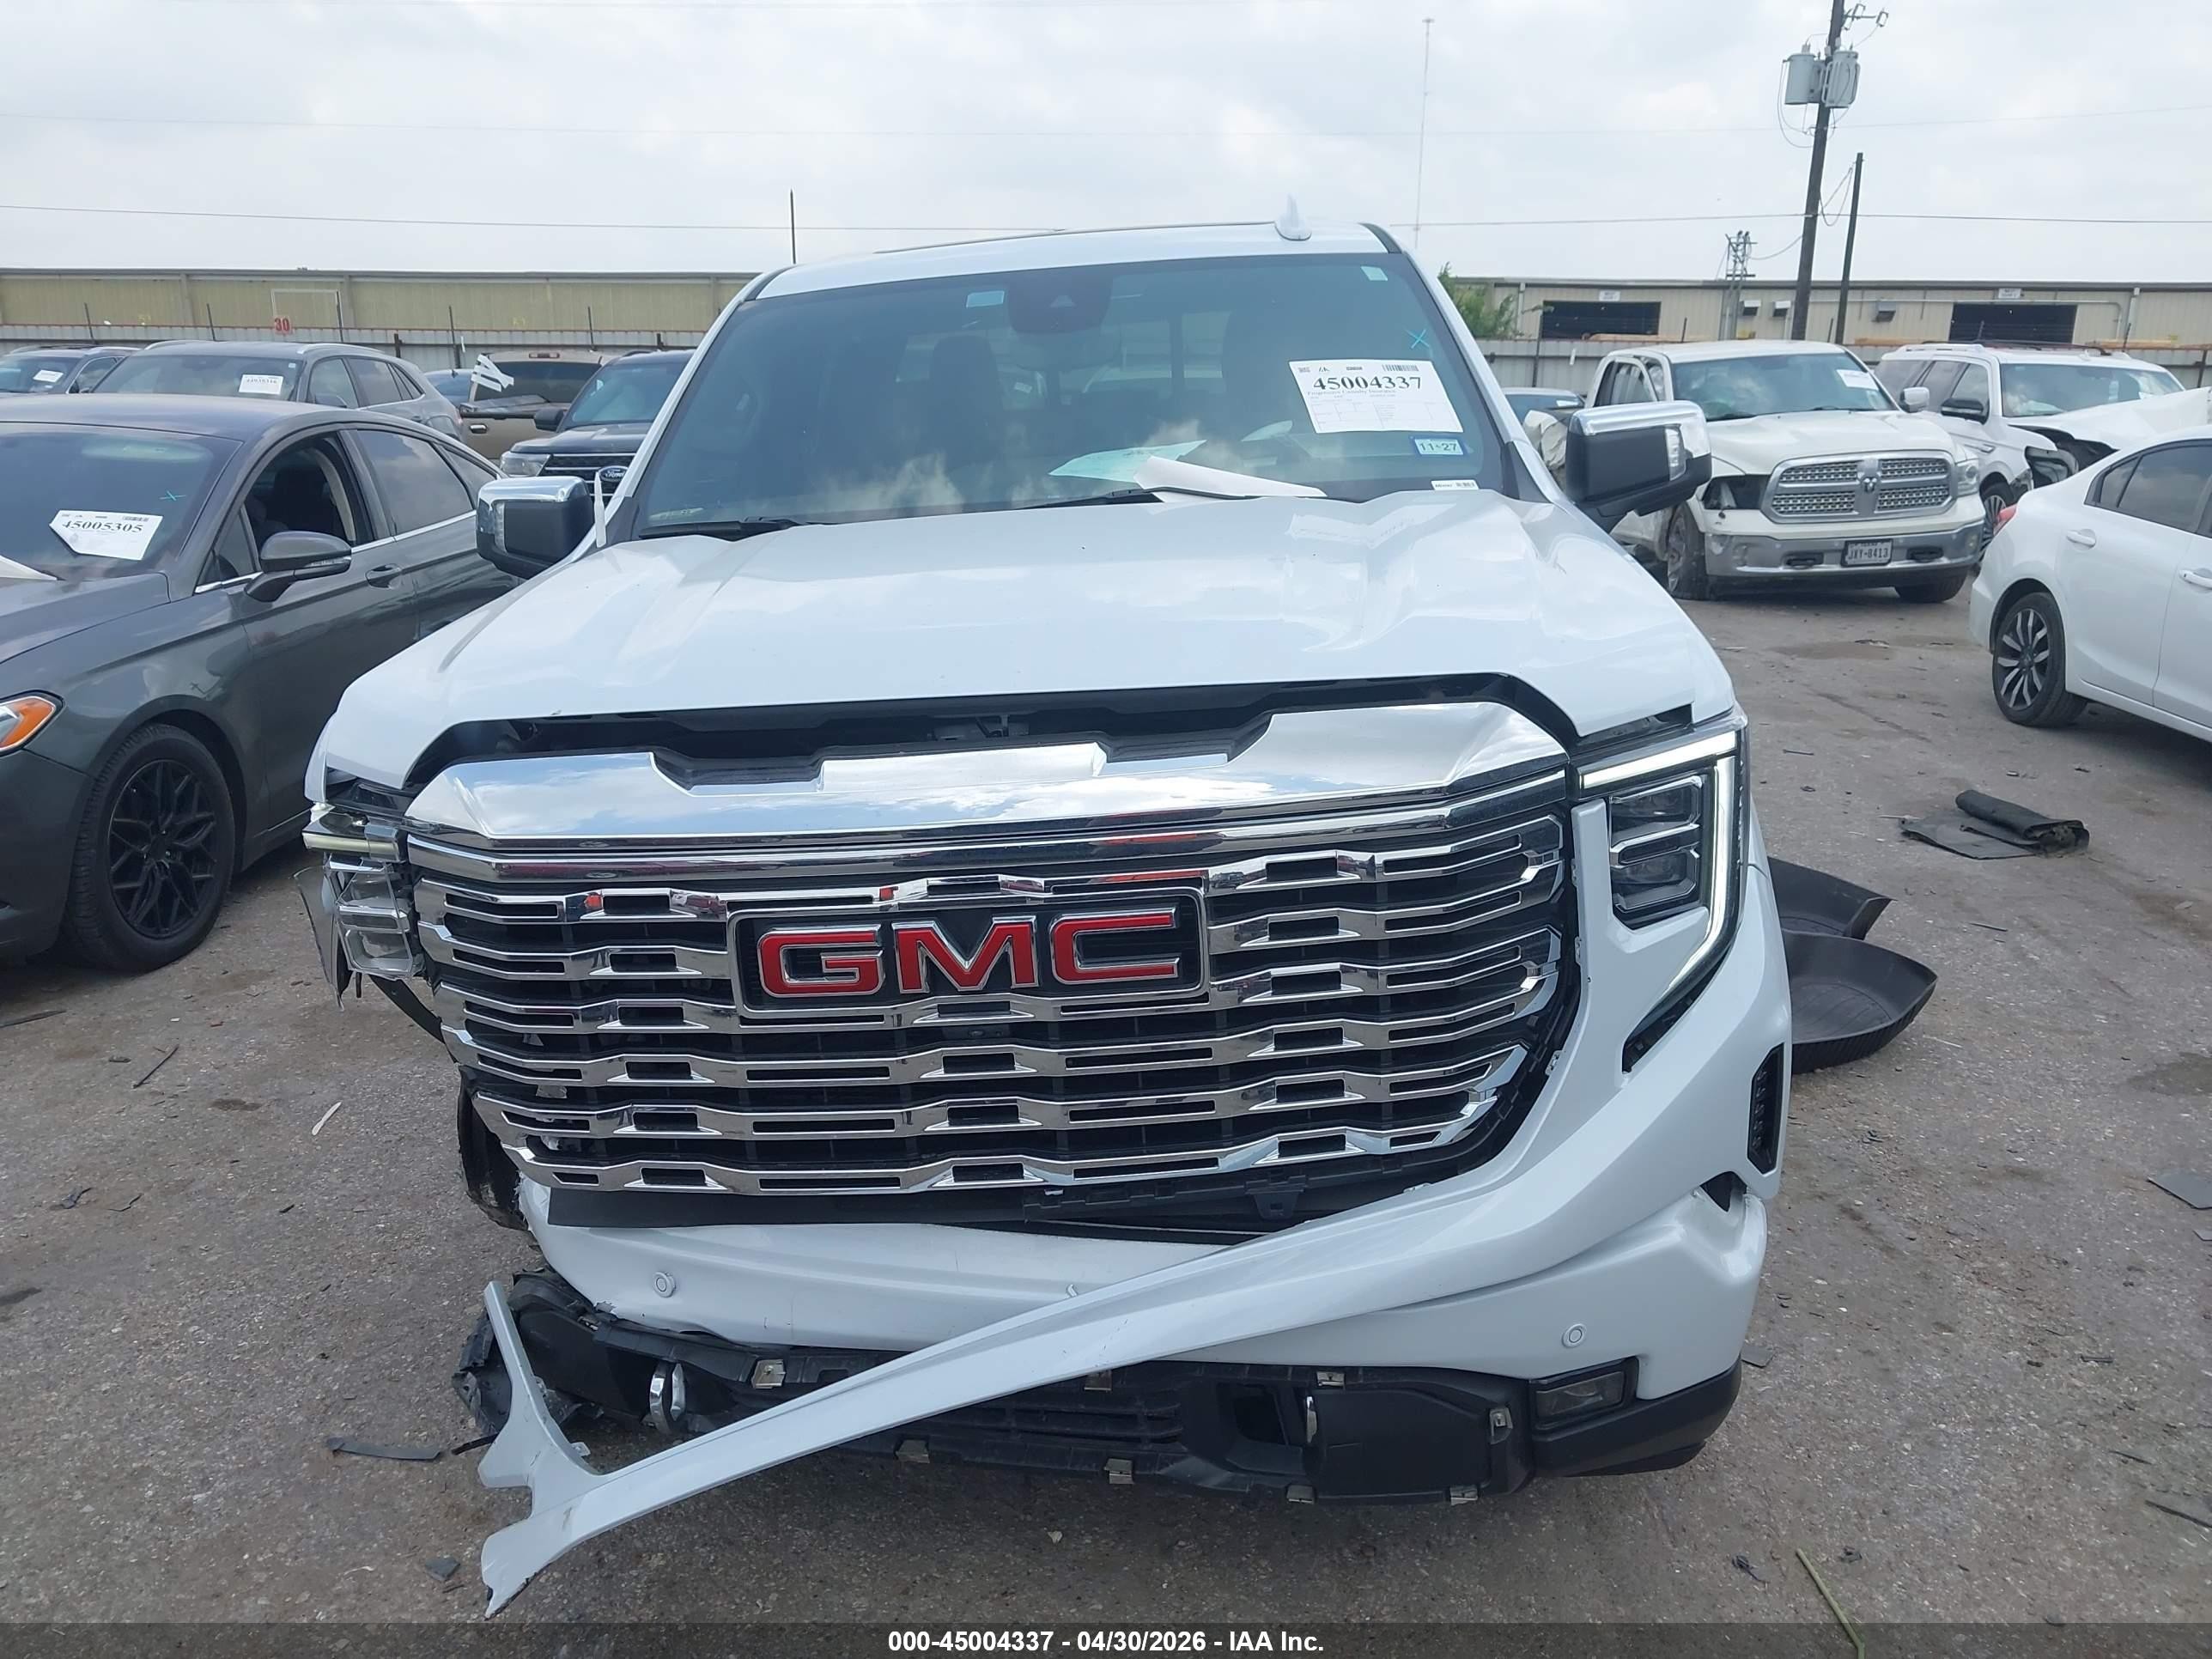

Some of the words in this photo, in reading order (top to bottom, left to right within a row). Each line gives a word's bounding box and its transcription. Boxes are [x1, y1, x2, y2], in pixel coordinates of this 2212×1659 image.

[274, 318, 289, 331] 30
[1314, 375, 1422, 390] 45004337
[1419, 442, 1458, 452] 11-27
[62, 520, 143, 533] 45005305
[758, 907, 1181, 998] GMC
